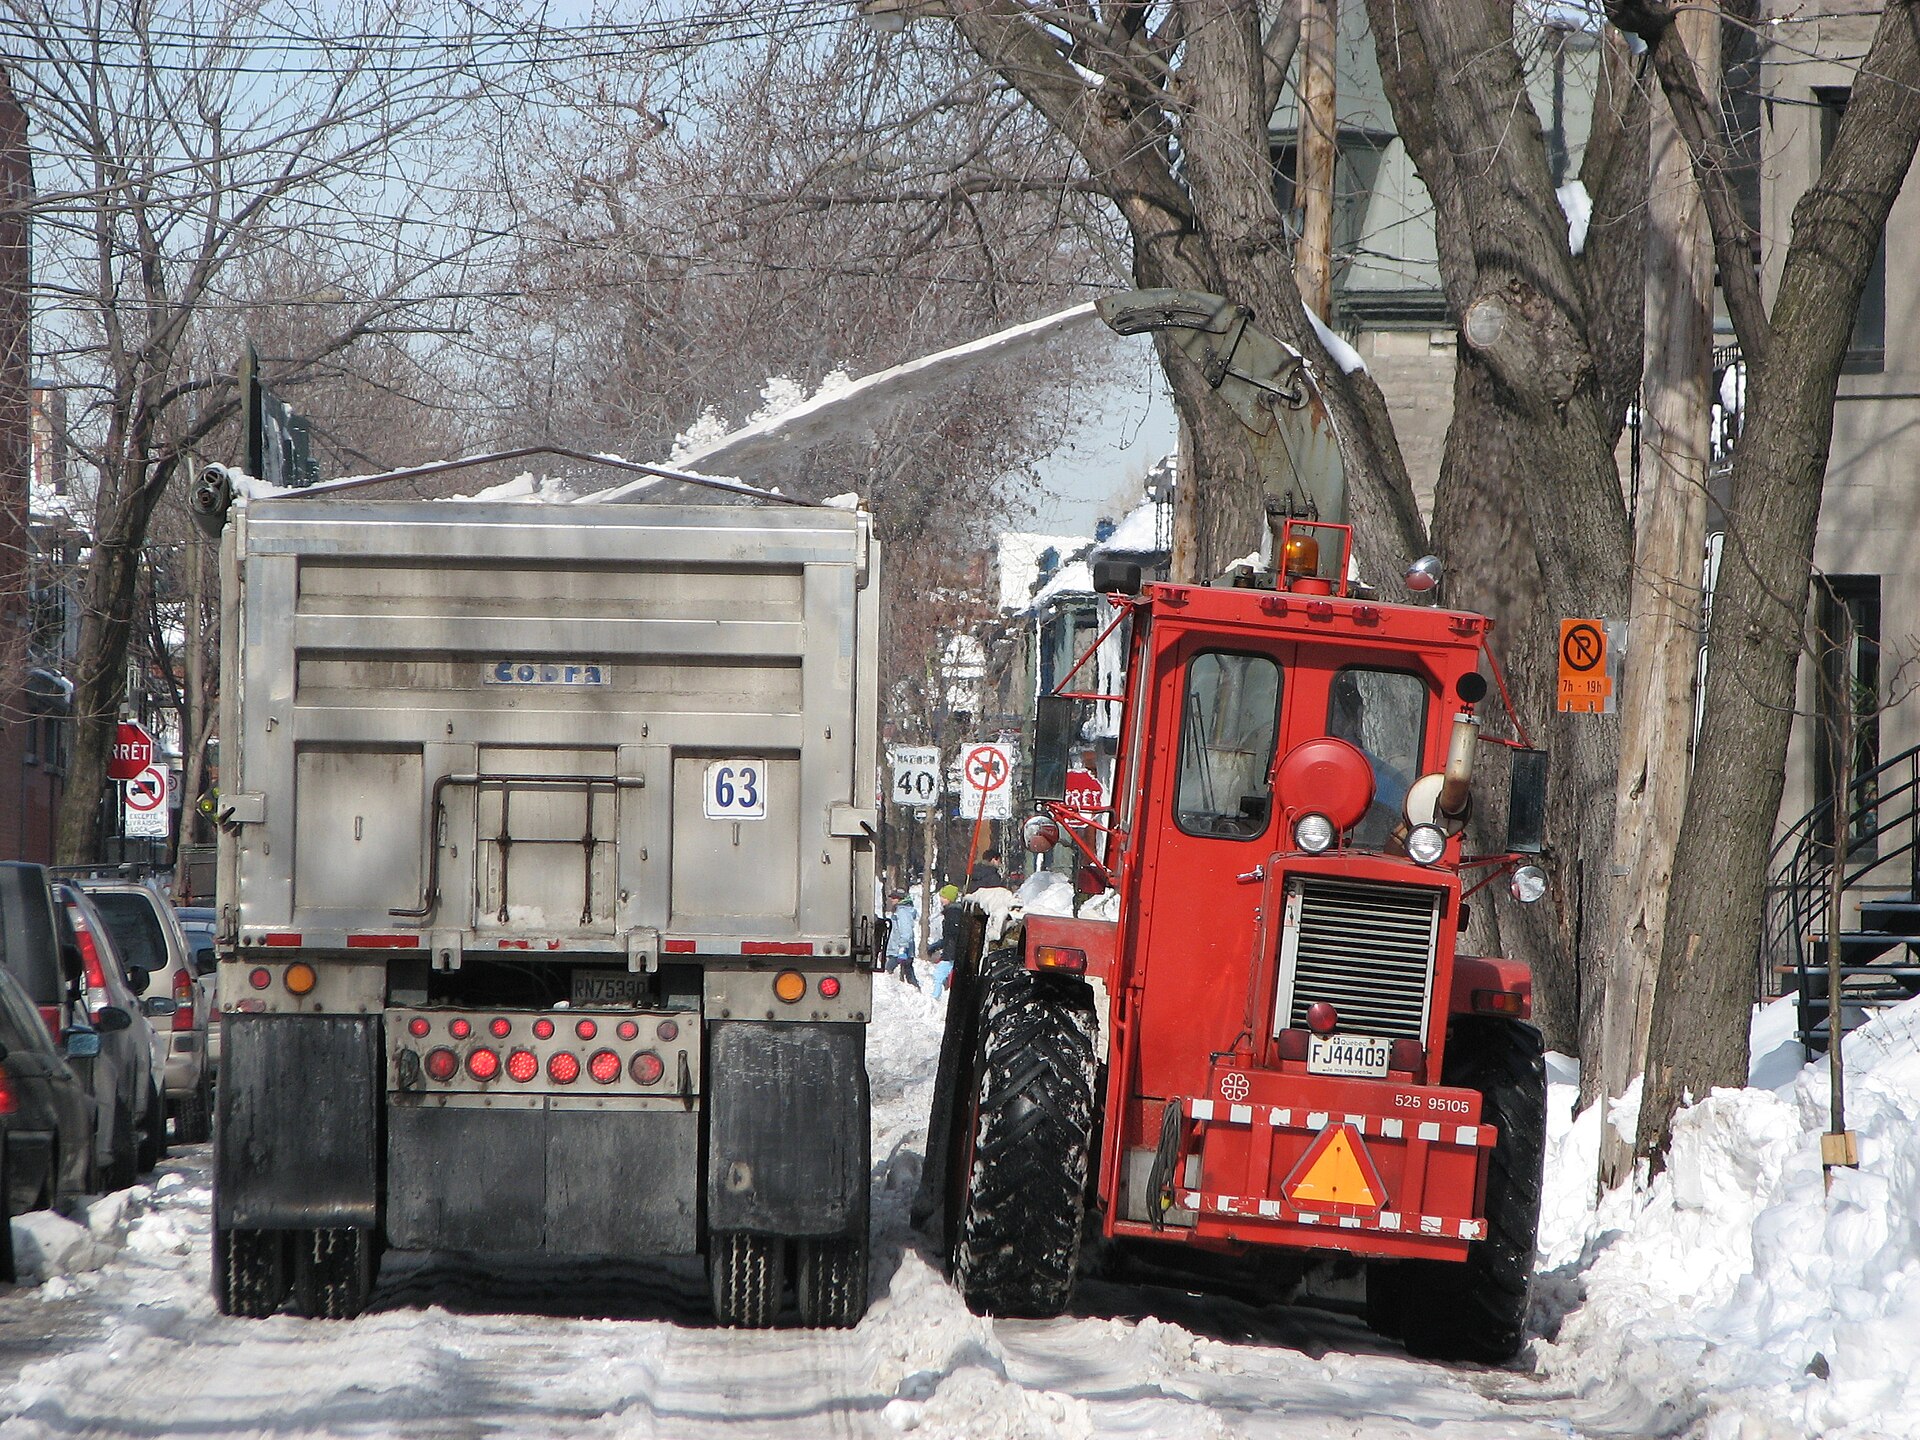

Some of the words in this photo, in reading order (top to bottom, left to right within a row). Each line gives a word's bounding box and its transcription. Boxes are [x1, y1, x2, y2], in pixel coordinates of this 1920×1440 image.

[494, 661, 601, 683] Cobra
[1563, 680, 1573, 692] 7h
[1587, 681, 1602, 693] 19h
[112, 741, 149, 760] RRÊT
[715, 767, 757, 808] 63
[898, 771, 935, 799] 40
[1313, 1044, 1385, 1067] FJ44403
[1395, 1094, 1421, 1108] 525
[1428, 1097, 1469, 1114] 95105
